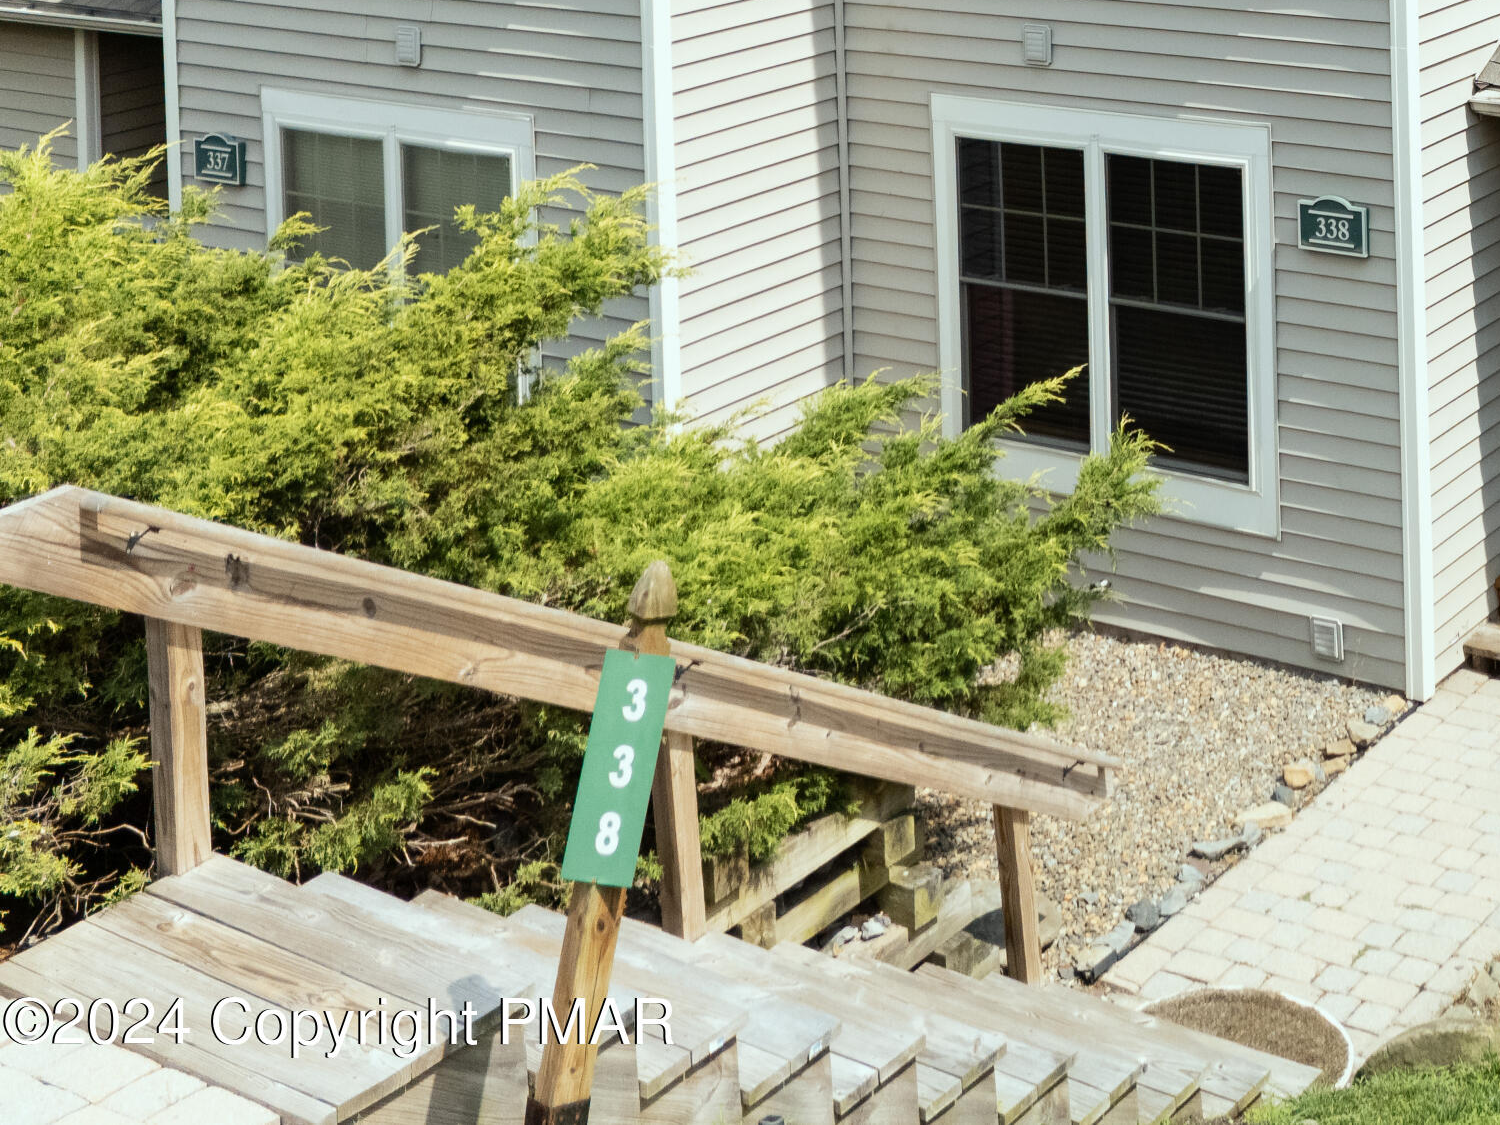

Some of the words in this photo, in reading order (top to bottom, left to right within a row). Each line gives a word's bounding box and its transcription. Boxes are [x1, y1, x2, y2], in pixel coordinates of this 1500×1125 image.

[206, 151, 229, 171] 337
[1315, 217, 1350, 241] 338
[594, 678, 648, 856] 338
